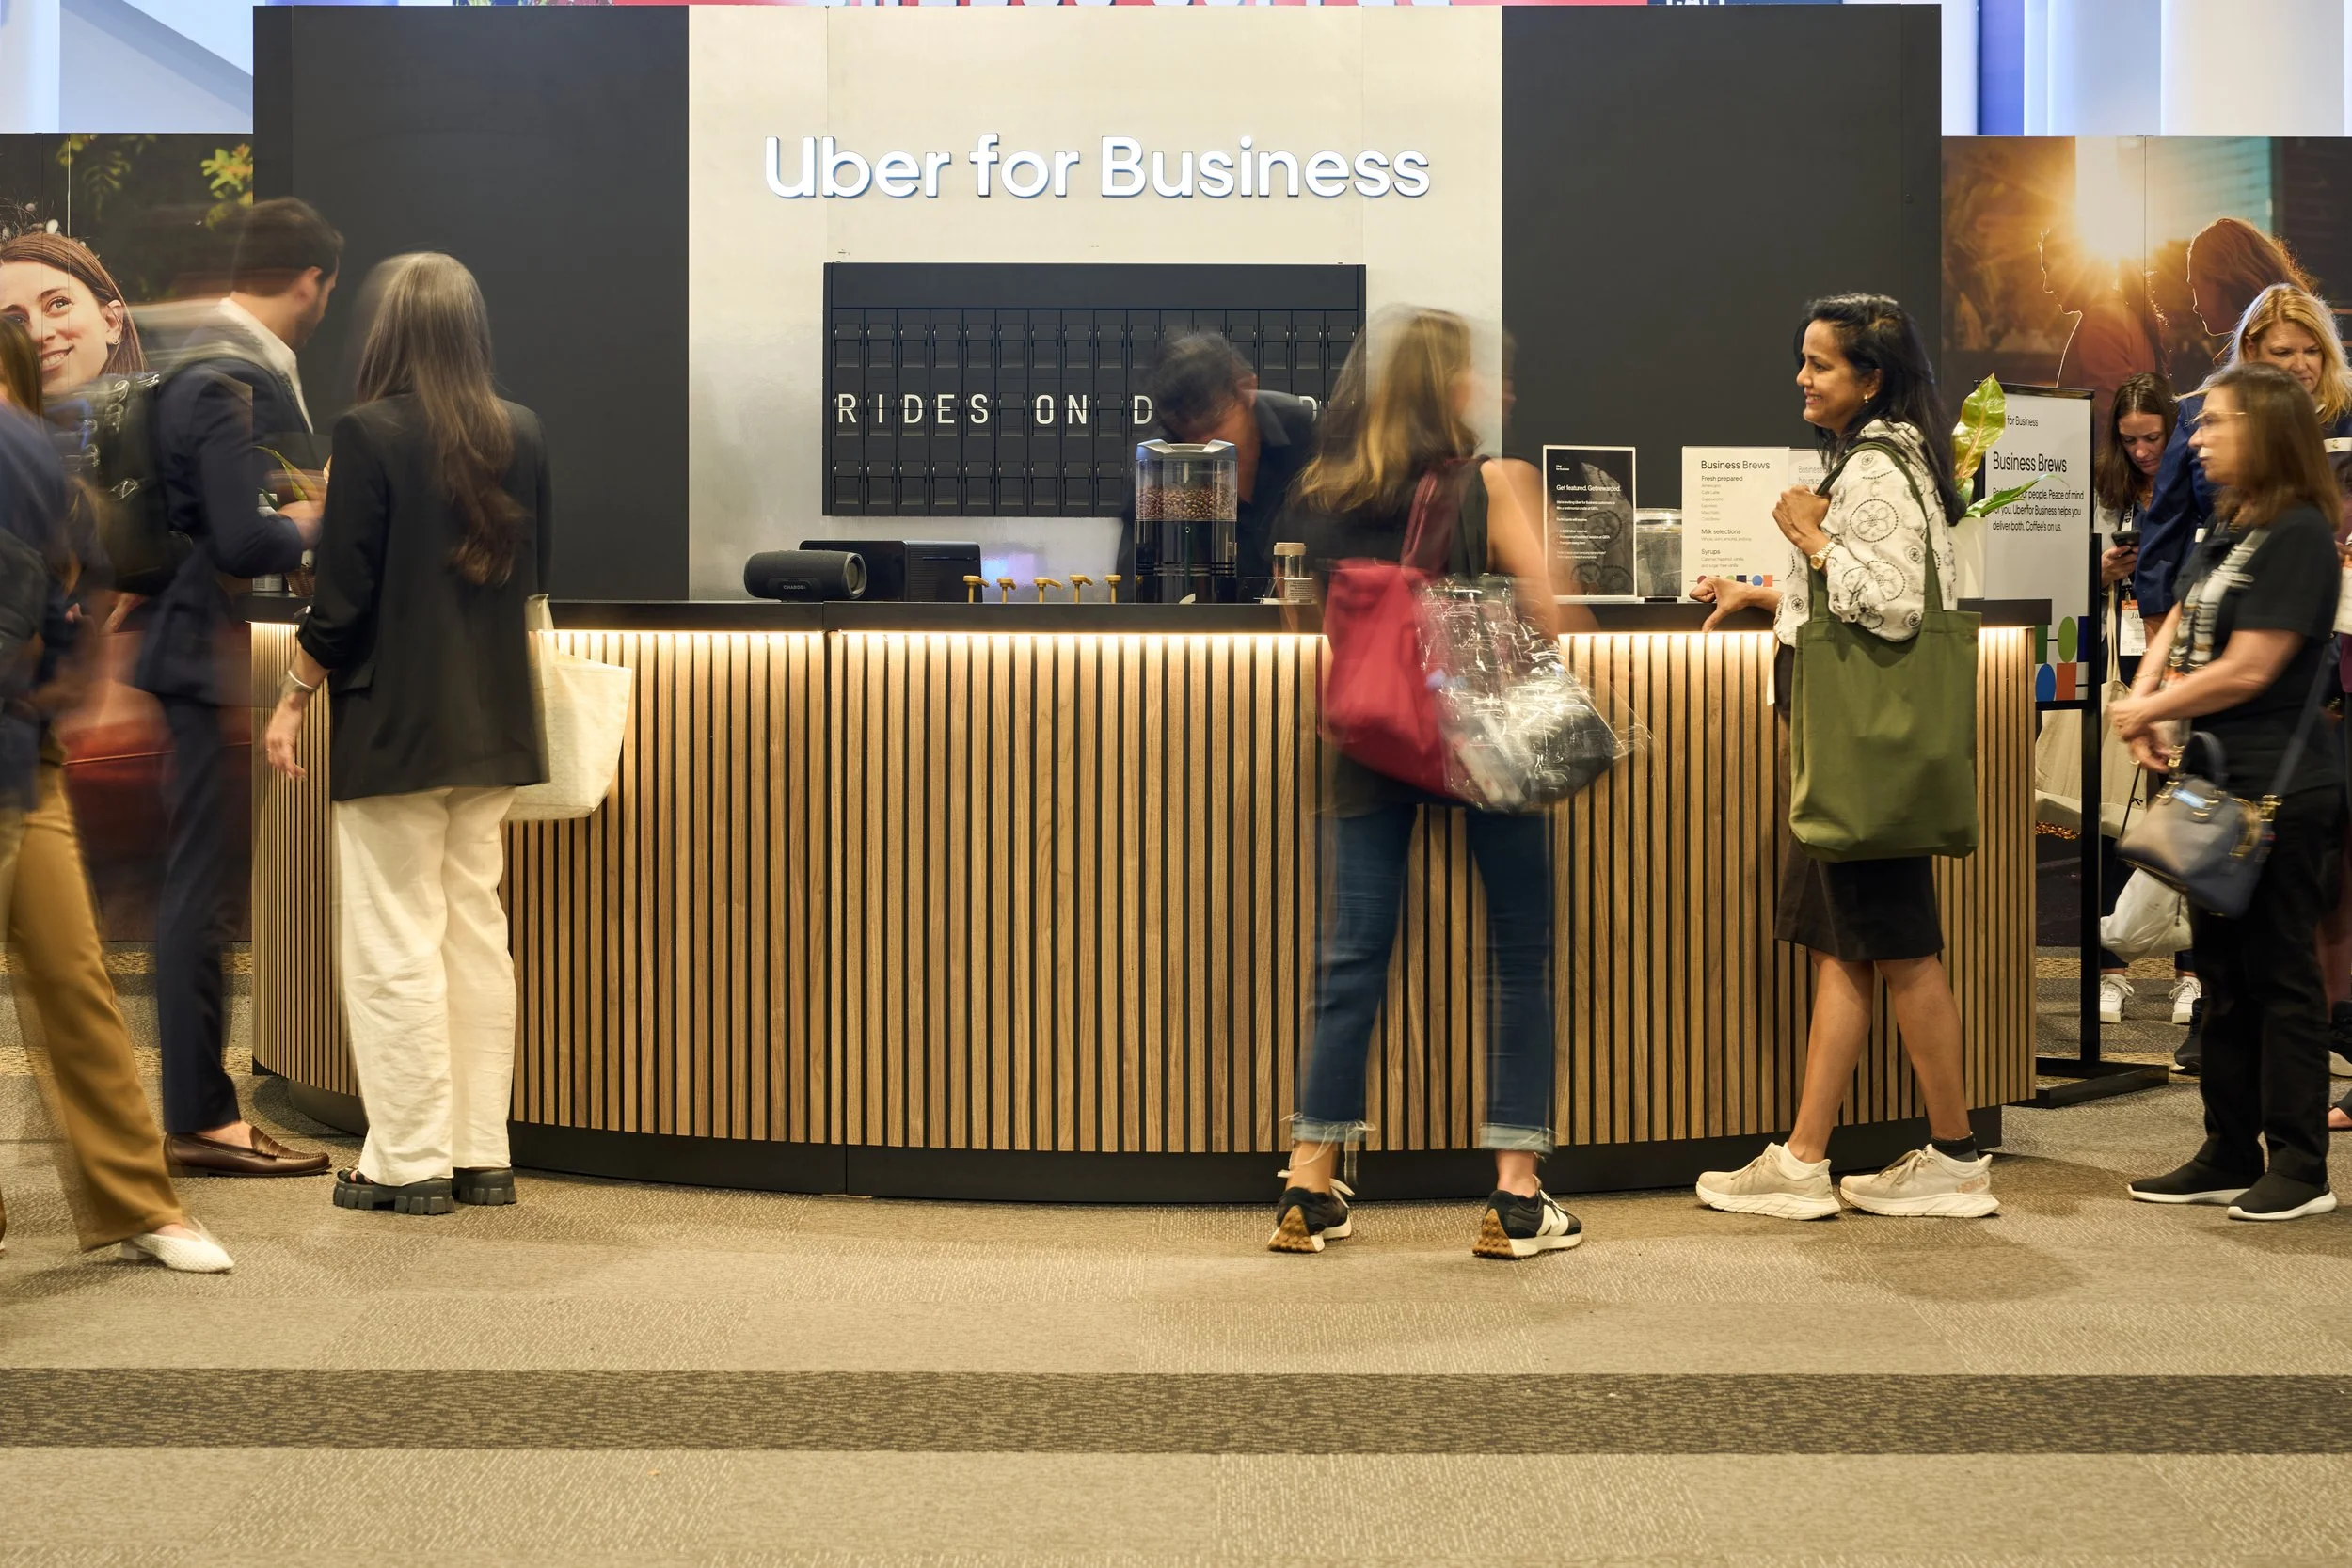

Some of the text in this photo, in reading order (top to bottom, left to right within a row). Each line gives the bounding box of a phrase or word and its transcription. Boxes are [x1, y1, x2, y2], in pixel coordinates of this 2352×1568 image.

[765, 133, 1430, 199] Uber for Business
[838, 393, 1088, 425] RIDES ON
[2015, 416, 2039, 427] Business
[1701, 460, 1770, 469] Business Brews
[1994, 451, 2068, 472] Business Brews
[1798, 465, 1822, 474] Business
[2028, 489, 2047, 501] people.
[2049, 489, 2064, 499] Peace
[2065, 490, 2071, 499] of
[2072, 490, 2085, 500] mind
[2013, 503, 2025, 515] Uber
[2035, 504, 2057, 515] Business
[2058, 505, 2071, 517] helps
[2072, 508, 2082, 518] you
[1993, 520, 2010, 531] deliver
[2026, 520, 2046, 531] Coffee's
